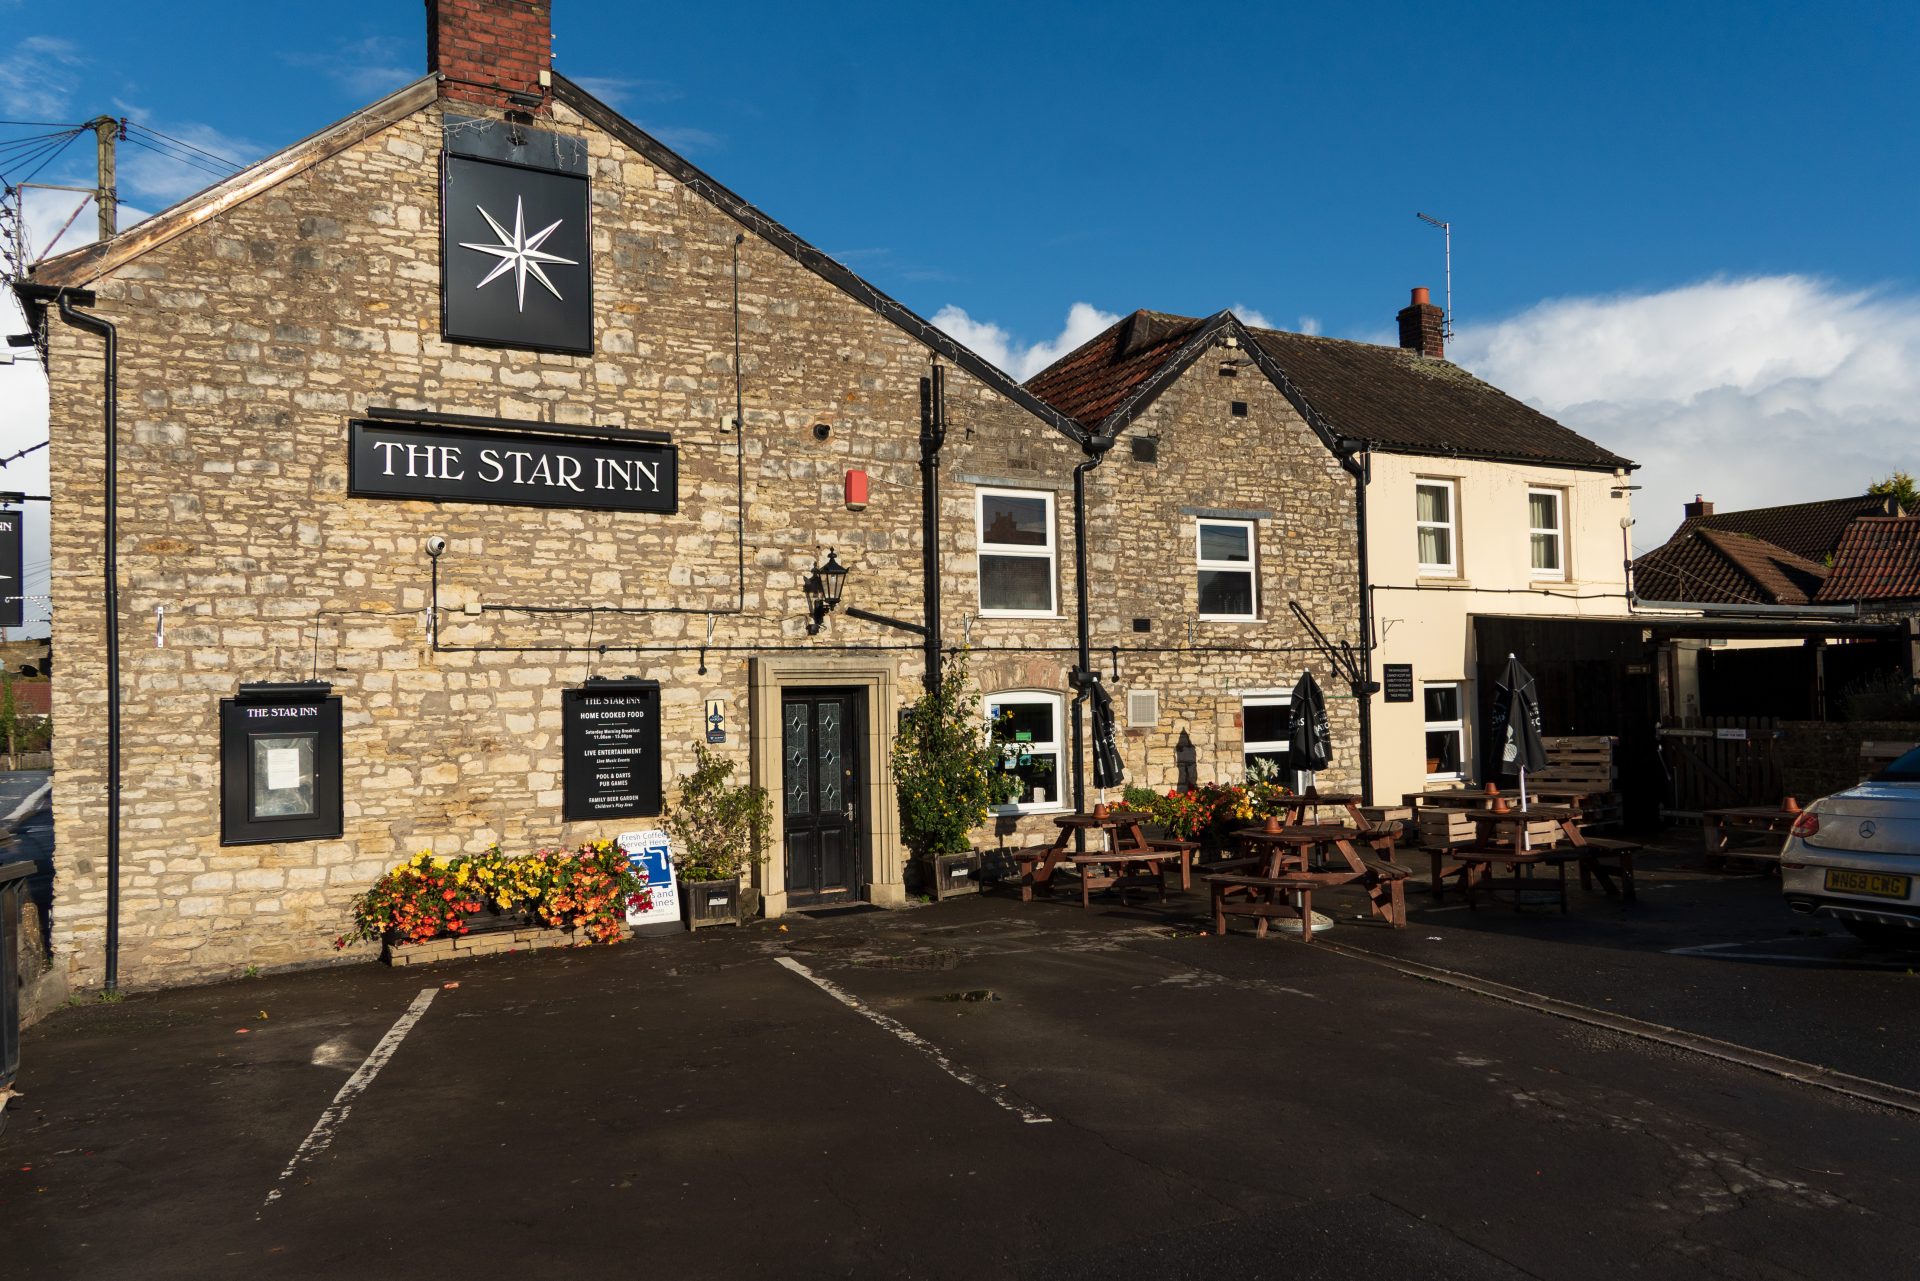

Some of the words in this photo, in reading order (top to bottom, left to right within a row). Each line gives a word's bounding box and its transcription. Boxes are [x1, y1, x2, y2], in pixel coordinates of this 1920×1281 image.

[373, 441, 465, 480] THE
[477, 450, 585, 492] STAR
[594, 458, 660, 492] INN
[584, 697, 601, 705] THE
[603, 697, 625, 706] STAR
[626, 696, 640, 705] INN
[247, 708, 269, 717] THE
[271, 708, 298, 717] STAR
[300, 707, 318, 716] INN
[597, 748, 641, 756] ENTERTAINMENT
[621, 833, 641, 841] Fresh
[621, 840, 647, 848] Served
[657, 890, 674, 898] and
